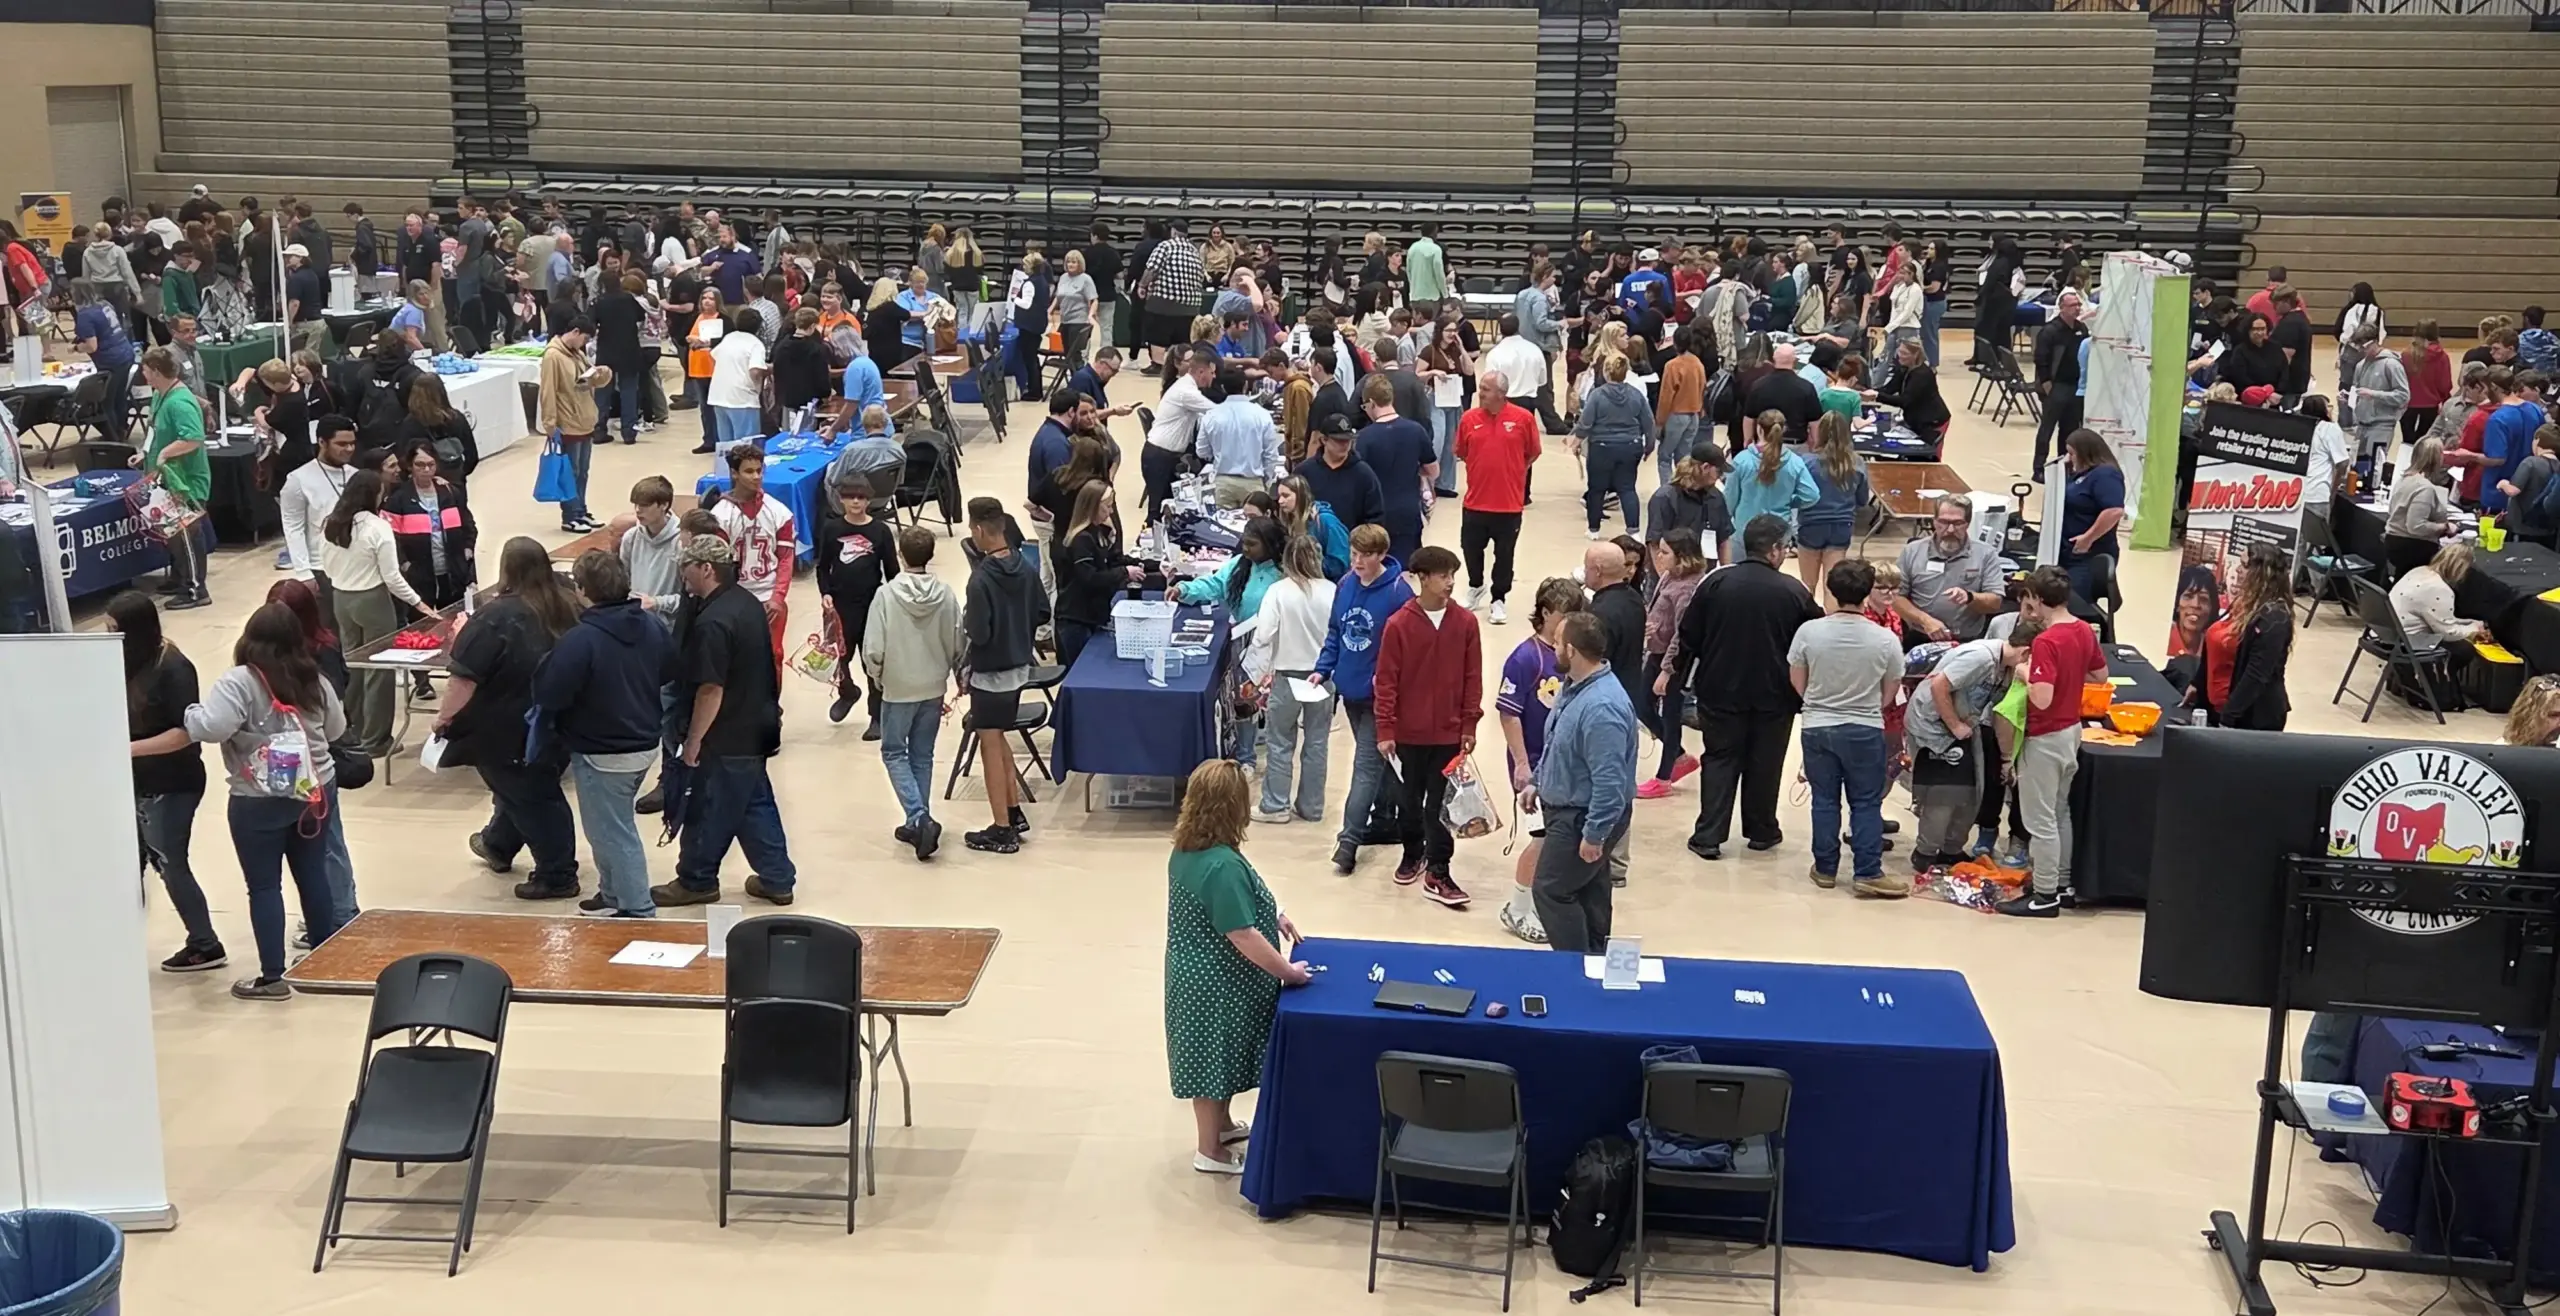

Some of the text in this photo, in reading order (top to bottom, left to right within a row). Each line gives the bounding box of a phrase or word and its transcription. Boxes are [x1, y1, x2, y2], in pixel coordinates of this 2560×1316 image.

[2209, 425, 2309, 454] Join the leading autoparts
[2216, 441, 2298, 464] retailer in the nation!
[2202, 474, 2303, 510] AutoZone
[735, 536, 771, 581] 13
[2342, 753, 2518, 820] OHIO VALLEY
